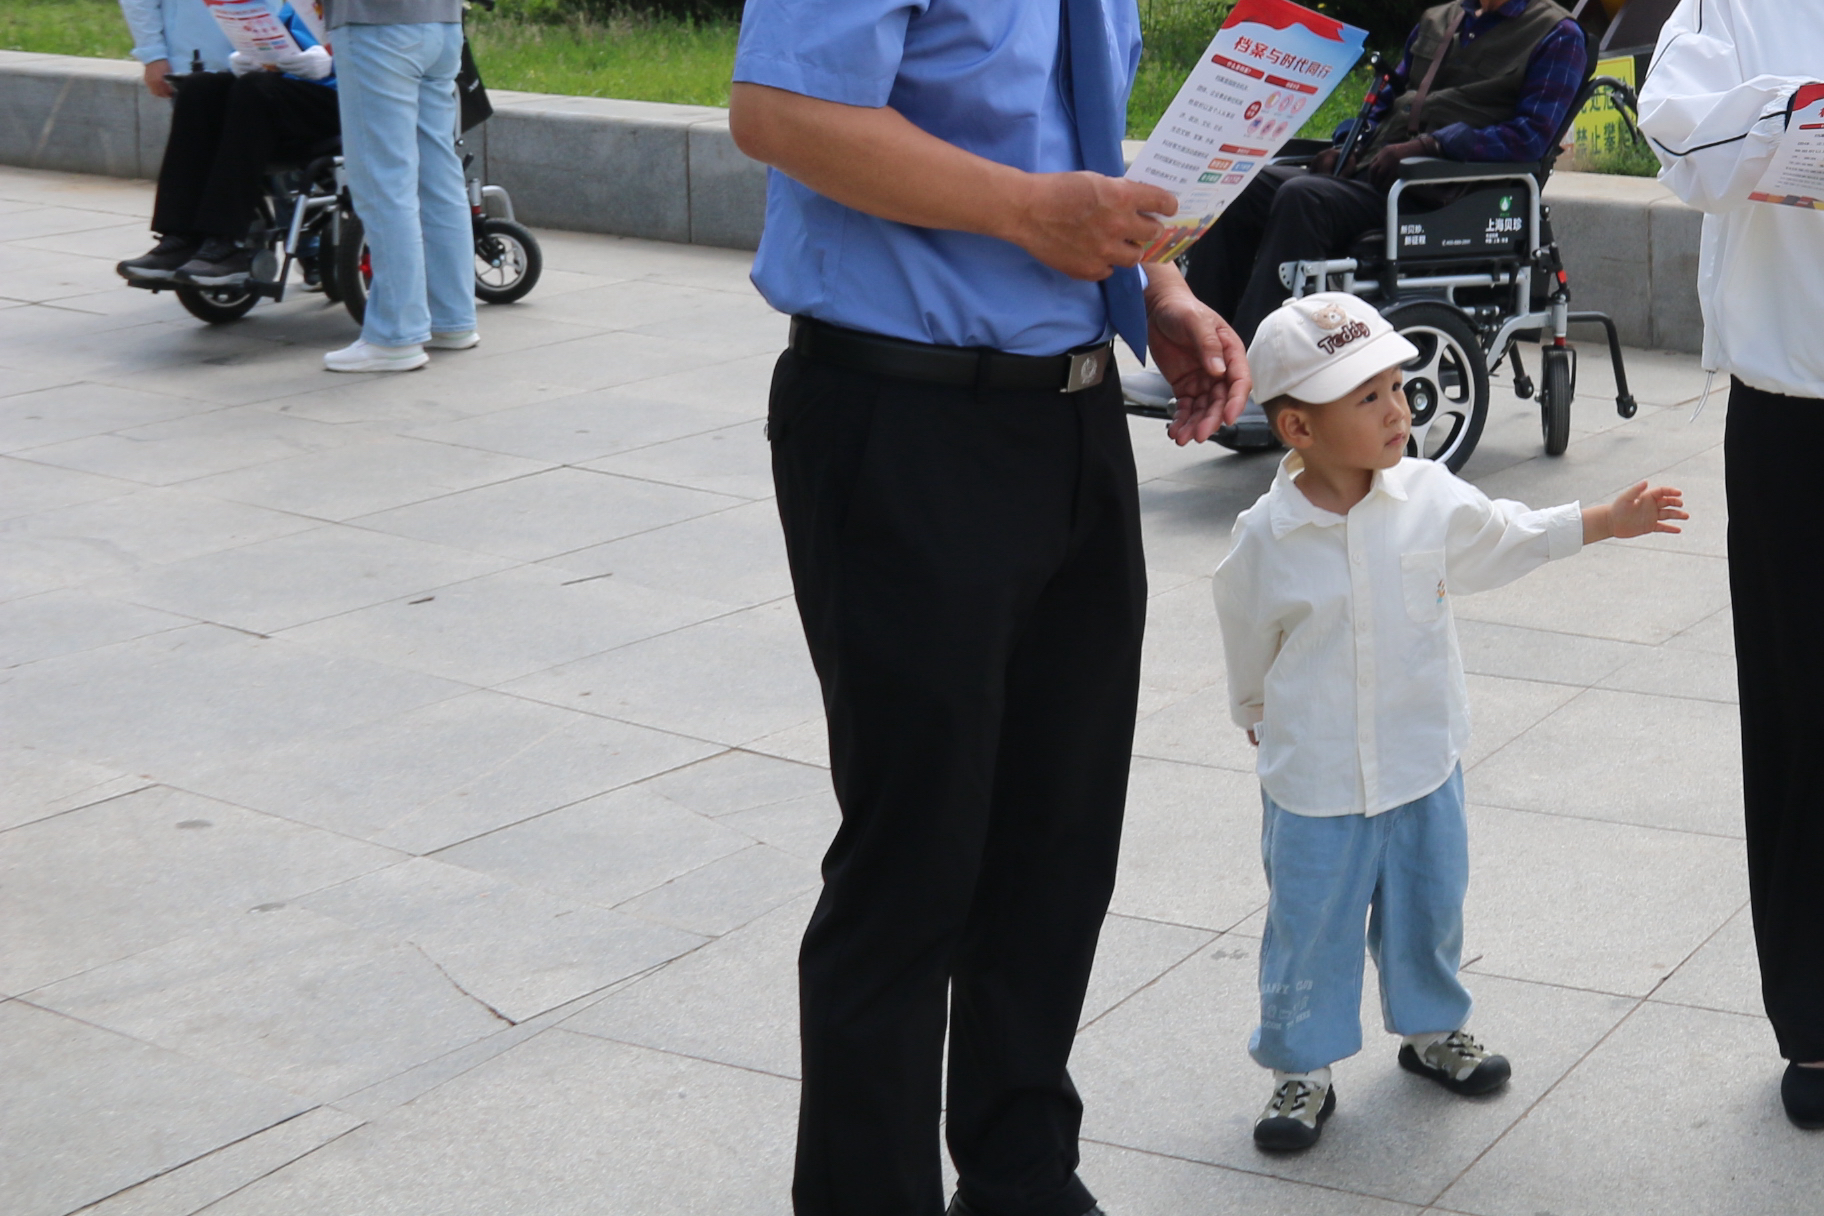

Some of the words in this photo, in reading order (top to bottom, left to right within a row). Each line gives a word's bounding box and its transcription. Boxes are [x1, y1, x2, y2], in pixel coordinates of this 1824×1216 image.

[1233, 35, 1334, 80] 档案与时代同行
[1317, 320, 1371, 355] Teddy
